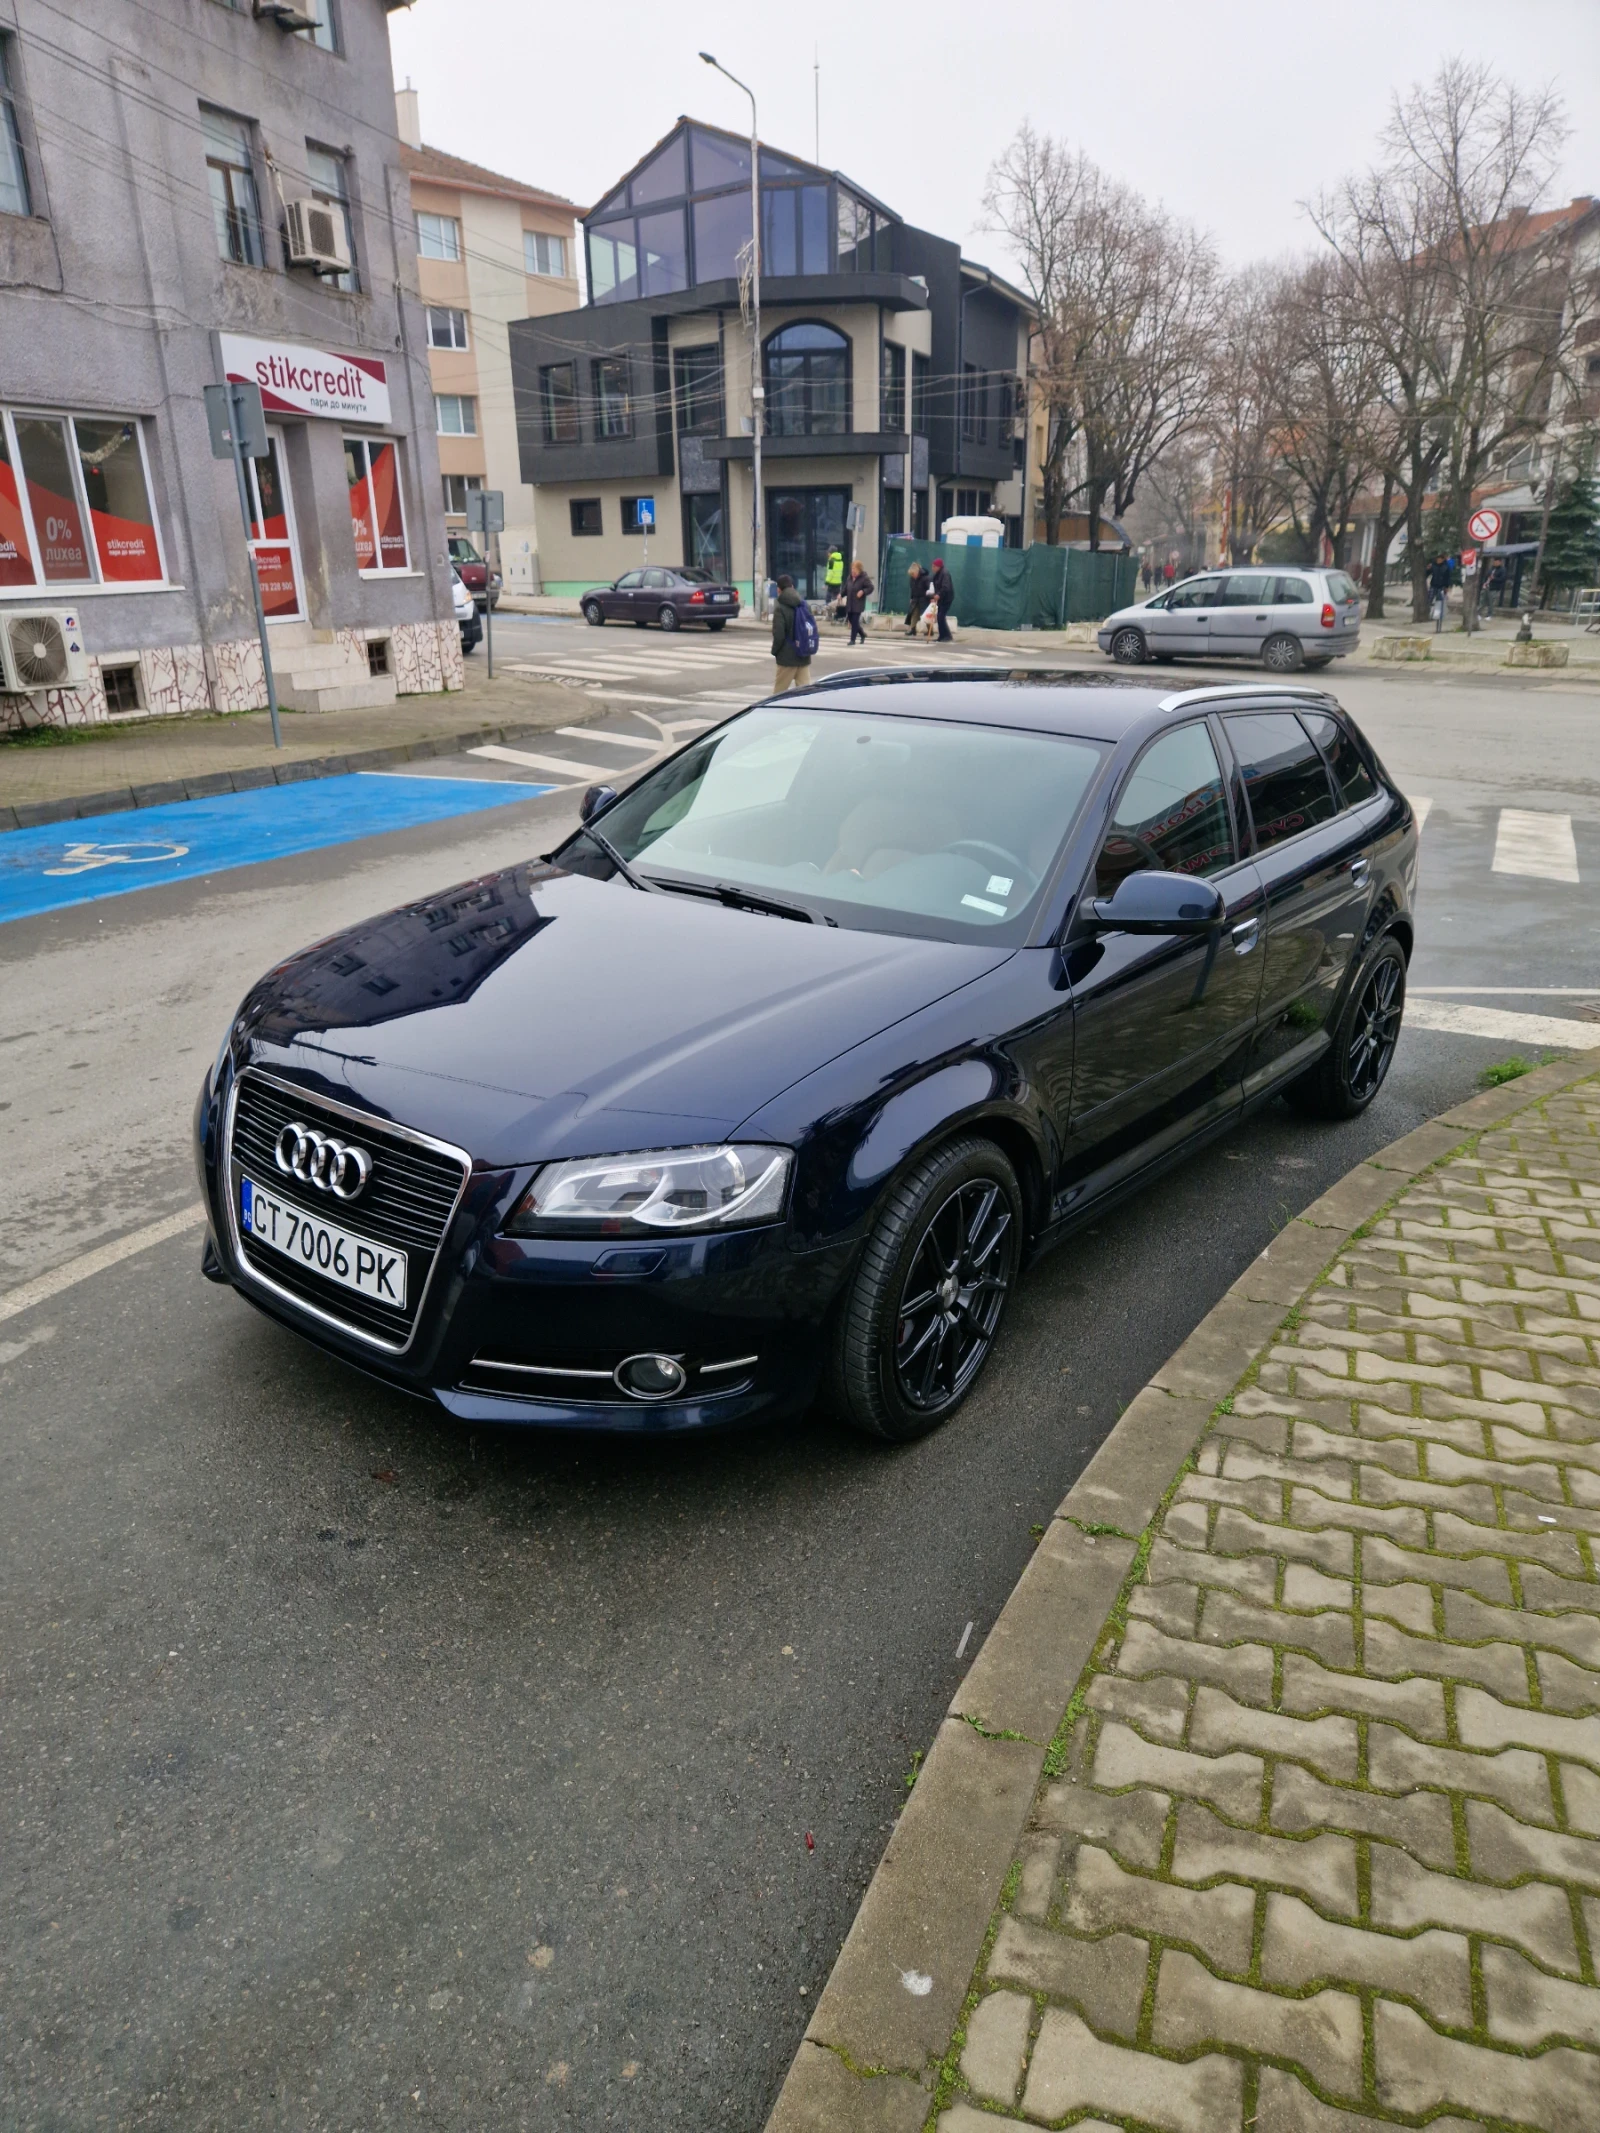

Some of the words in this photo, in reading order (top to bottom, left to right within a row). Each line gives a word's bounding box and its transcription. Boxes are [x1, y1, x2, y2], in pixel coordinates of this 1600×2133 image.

[256, 355, 365, 399] stikcredit
[310, 398, 329, 409] пари
[330, 401, 341, 410] до
[46, 516, 72, 541] 0%
[254, 1193, 281, 1242] CT
[285, 1211, 349, 1278] 7006
[356, 1244, 398, 1299] PK
